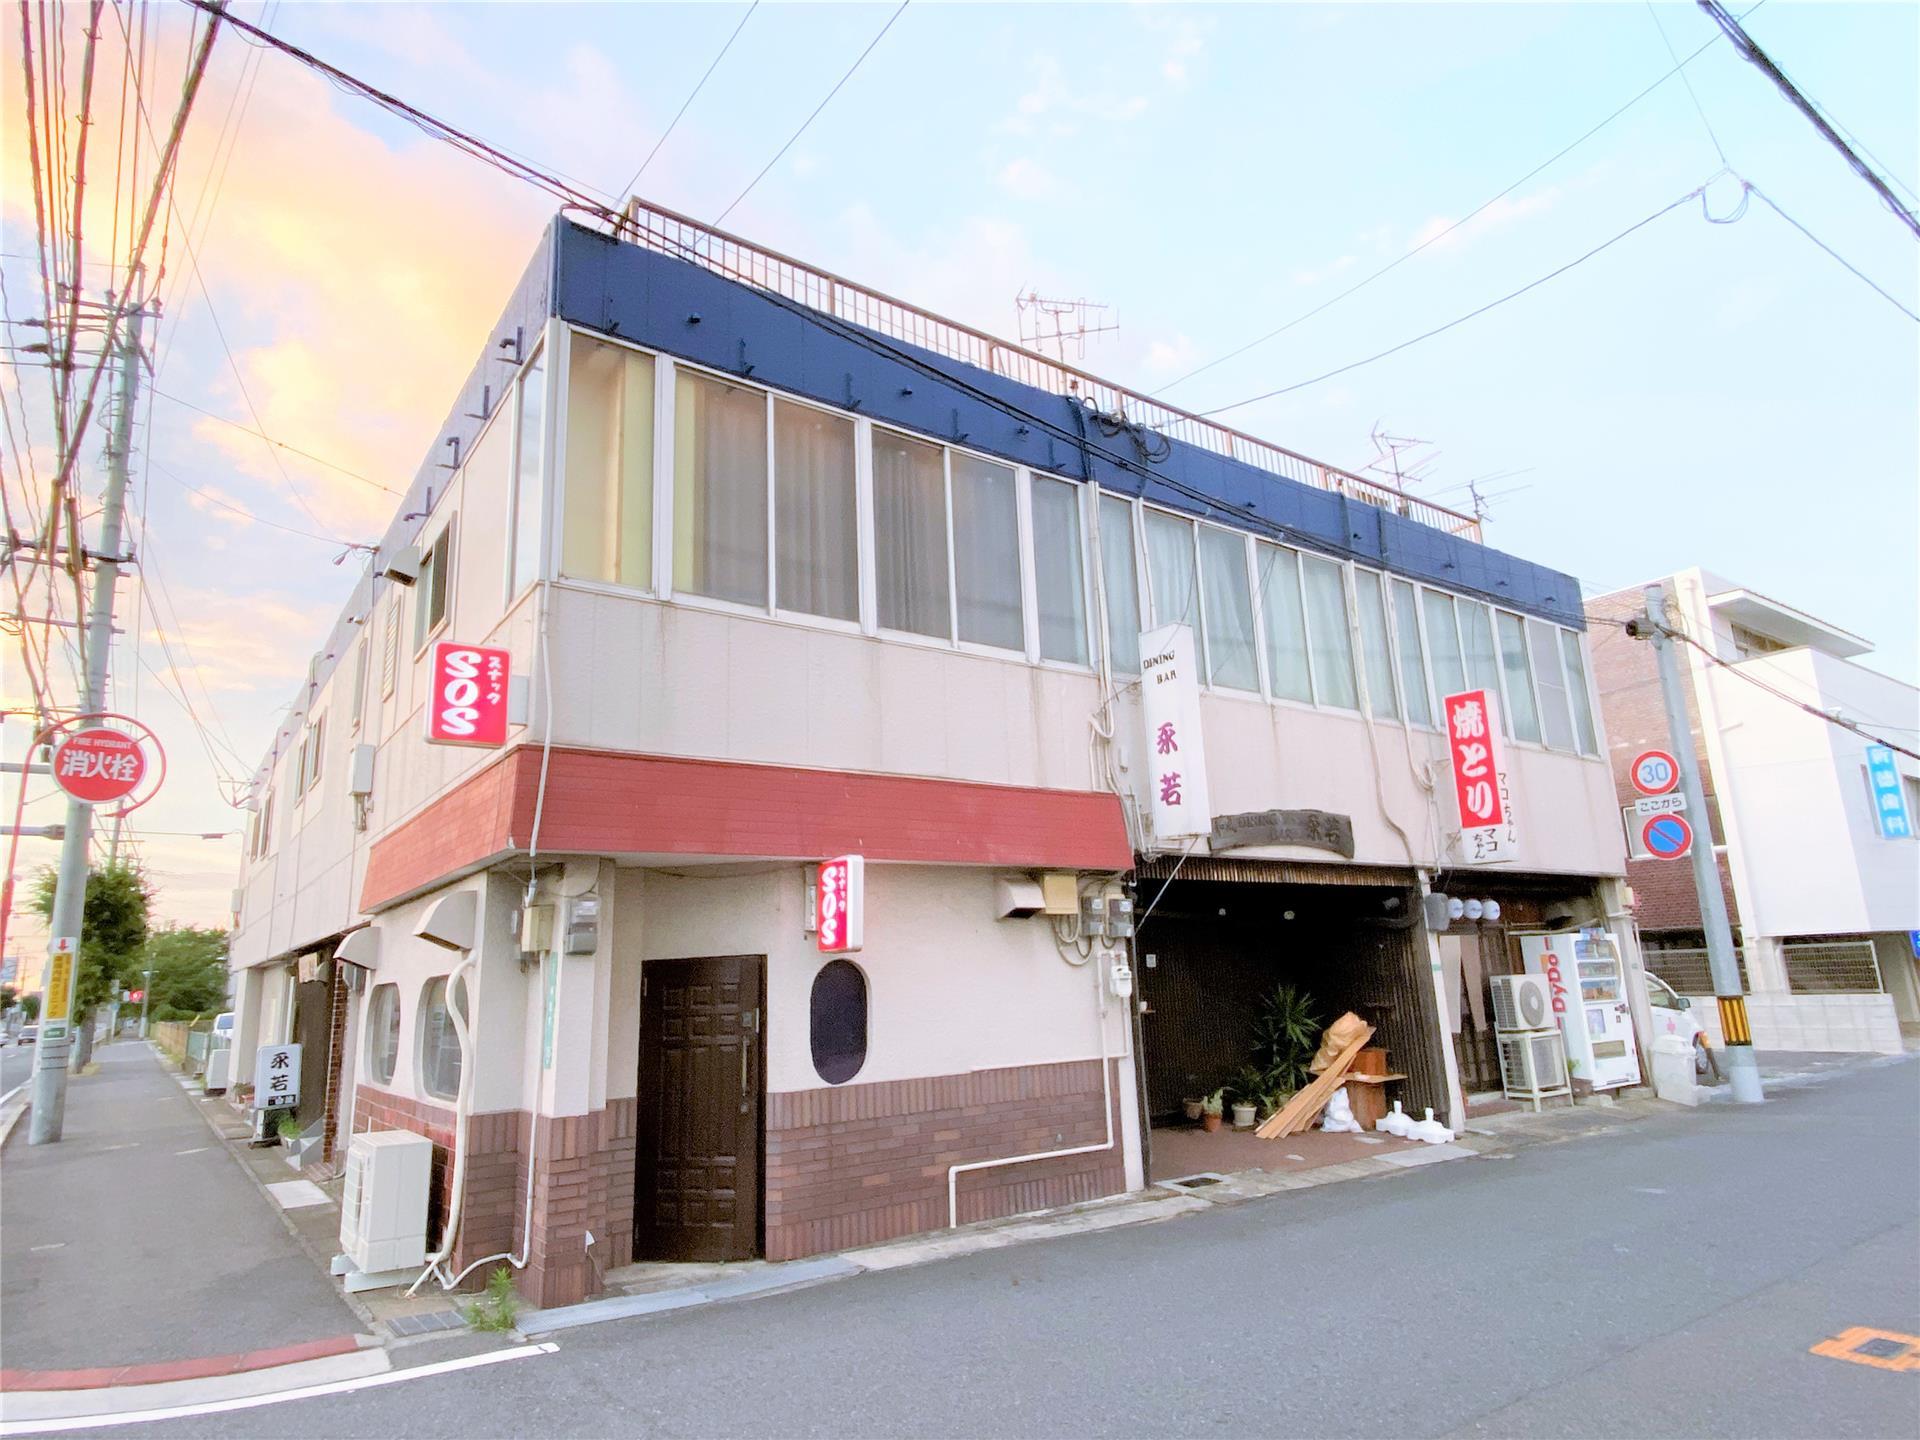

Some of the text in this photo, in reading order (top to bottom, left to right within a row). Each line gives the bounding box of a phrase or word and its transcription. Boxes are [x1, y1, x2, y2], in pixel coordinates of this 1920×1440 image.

[486, 655, 503, 705] スナック
[1143, 650, 1175, 669] DINING
[1156, 669, 1177, 685] BAR
[441, 650, 483, 736] SOS
[60, 748, 138, 782] 消火栓
[1453, 700, 1493, 820] 焼とり
[1642, 762, 1668, 784] 30
[1640, 797, 1682, 813] ここから
[821, 866, 837, 945] SOS
[838, 865, 846, 913] スナック
